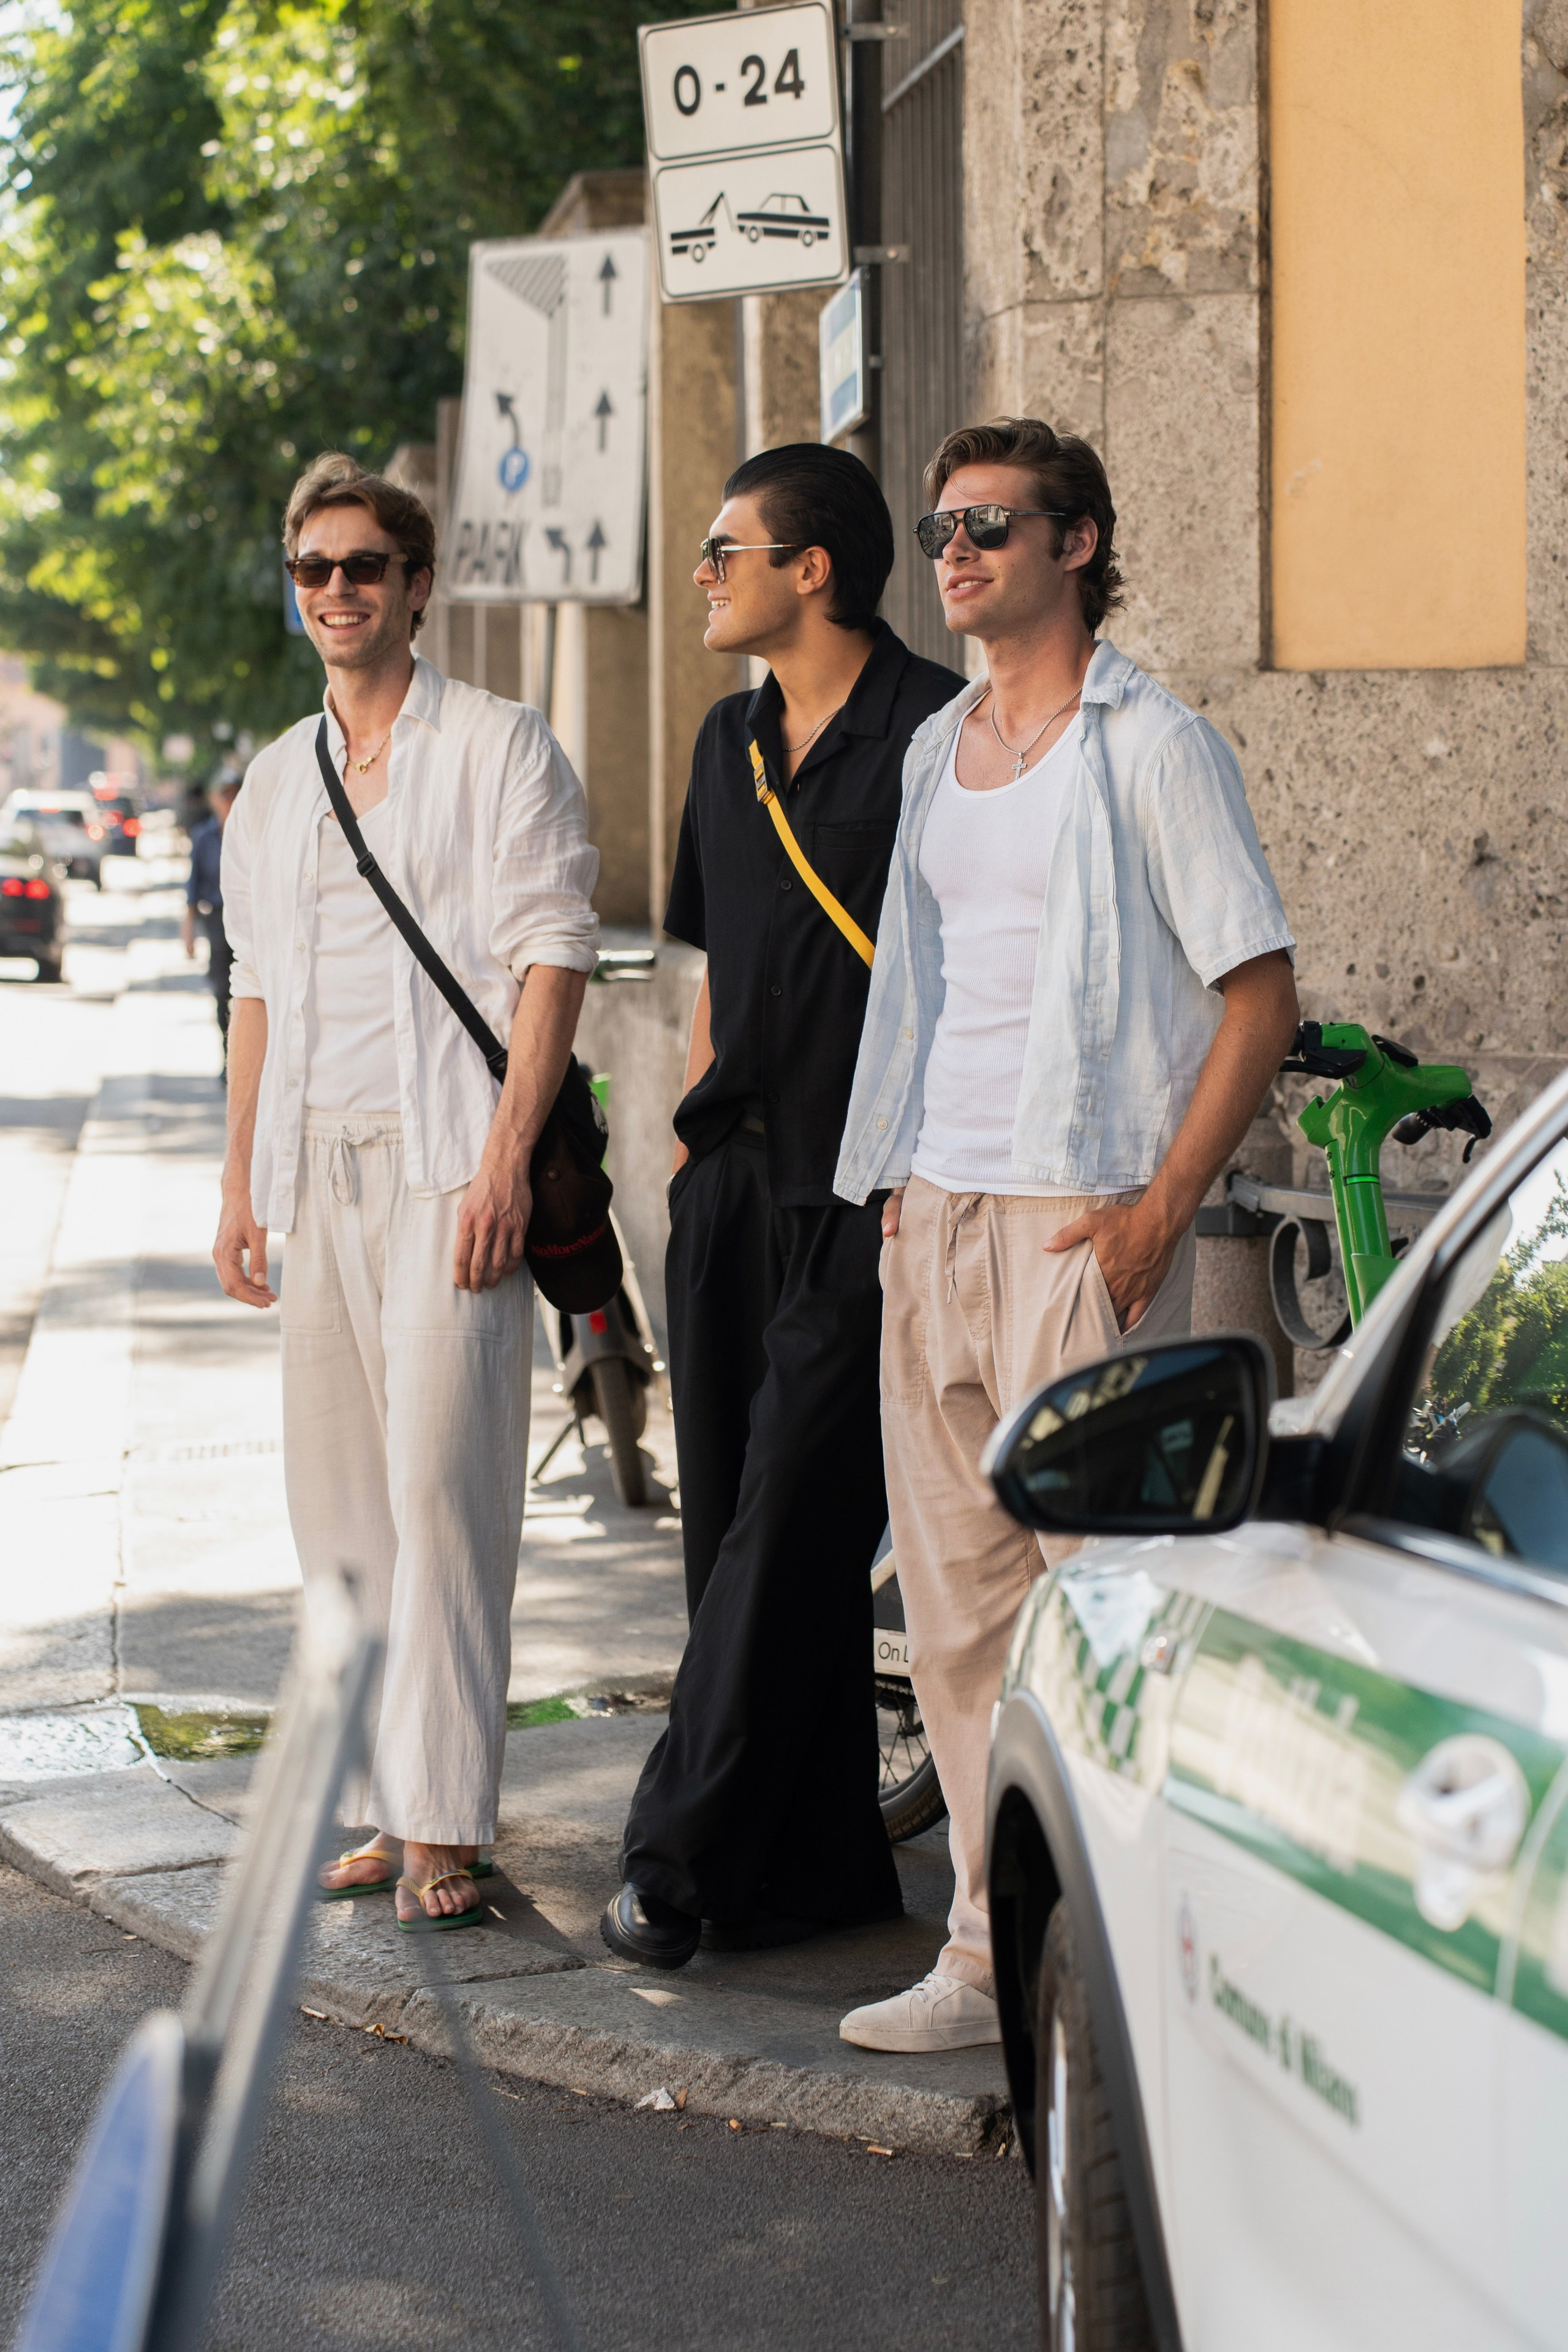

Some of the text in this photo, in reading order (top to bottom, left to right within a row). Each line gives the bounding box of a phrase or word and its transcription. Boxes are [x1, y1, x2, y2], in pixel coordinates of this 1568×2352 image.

[674, 48, 805, 116] 0 - 24
[504, 451, 526, 488] P
[878, 1642, 900, 1661] On
